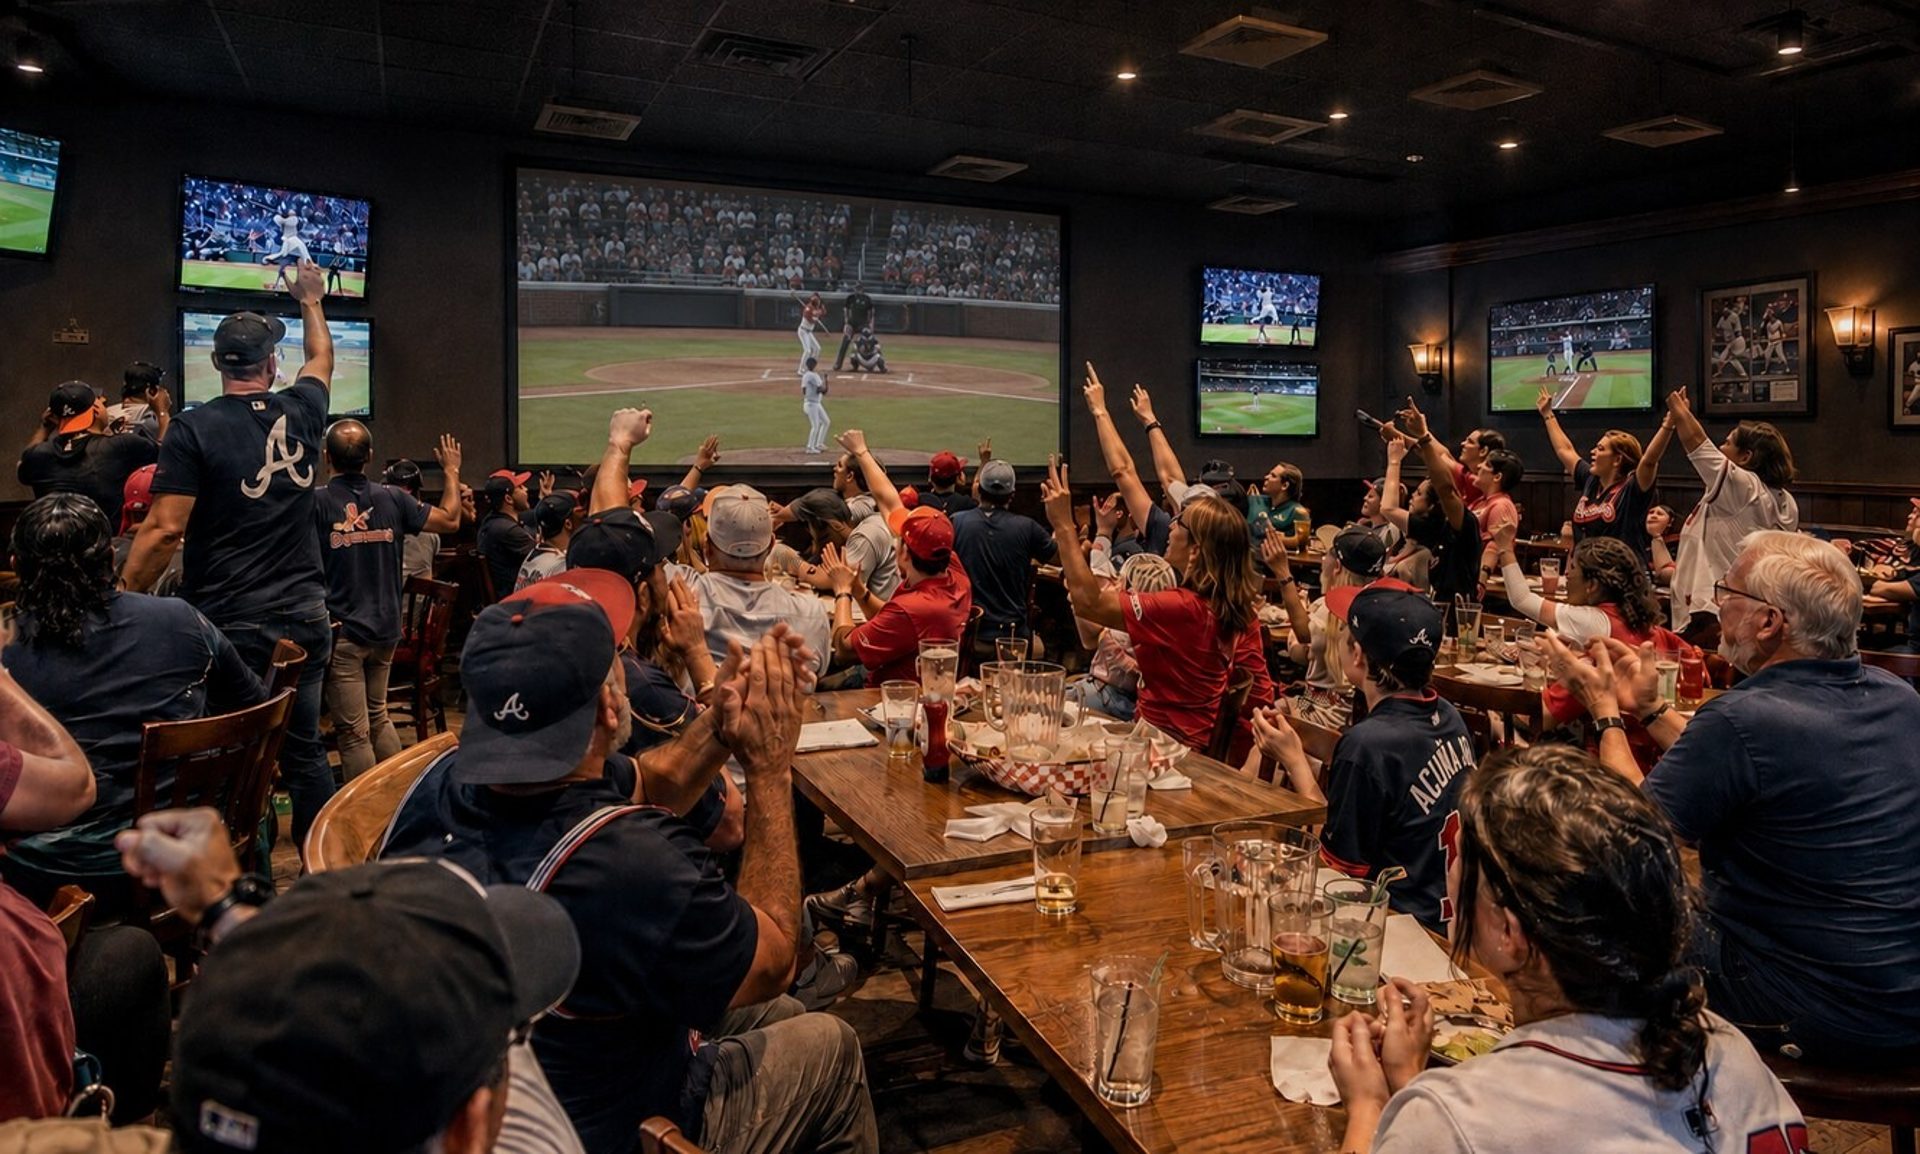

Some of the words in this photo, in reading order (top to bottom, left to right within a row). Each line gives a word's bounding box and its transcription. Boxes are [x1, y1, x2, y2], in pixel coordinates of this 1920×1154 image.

[241, 414, 314, 498] A
[1409, 628, 1432, 647] A
[494, 692, 529, 720] A
